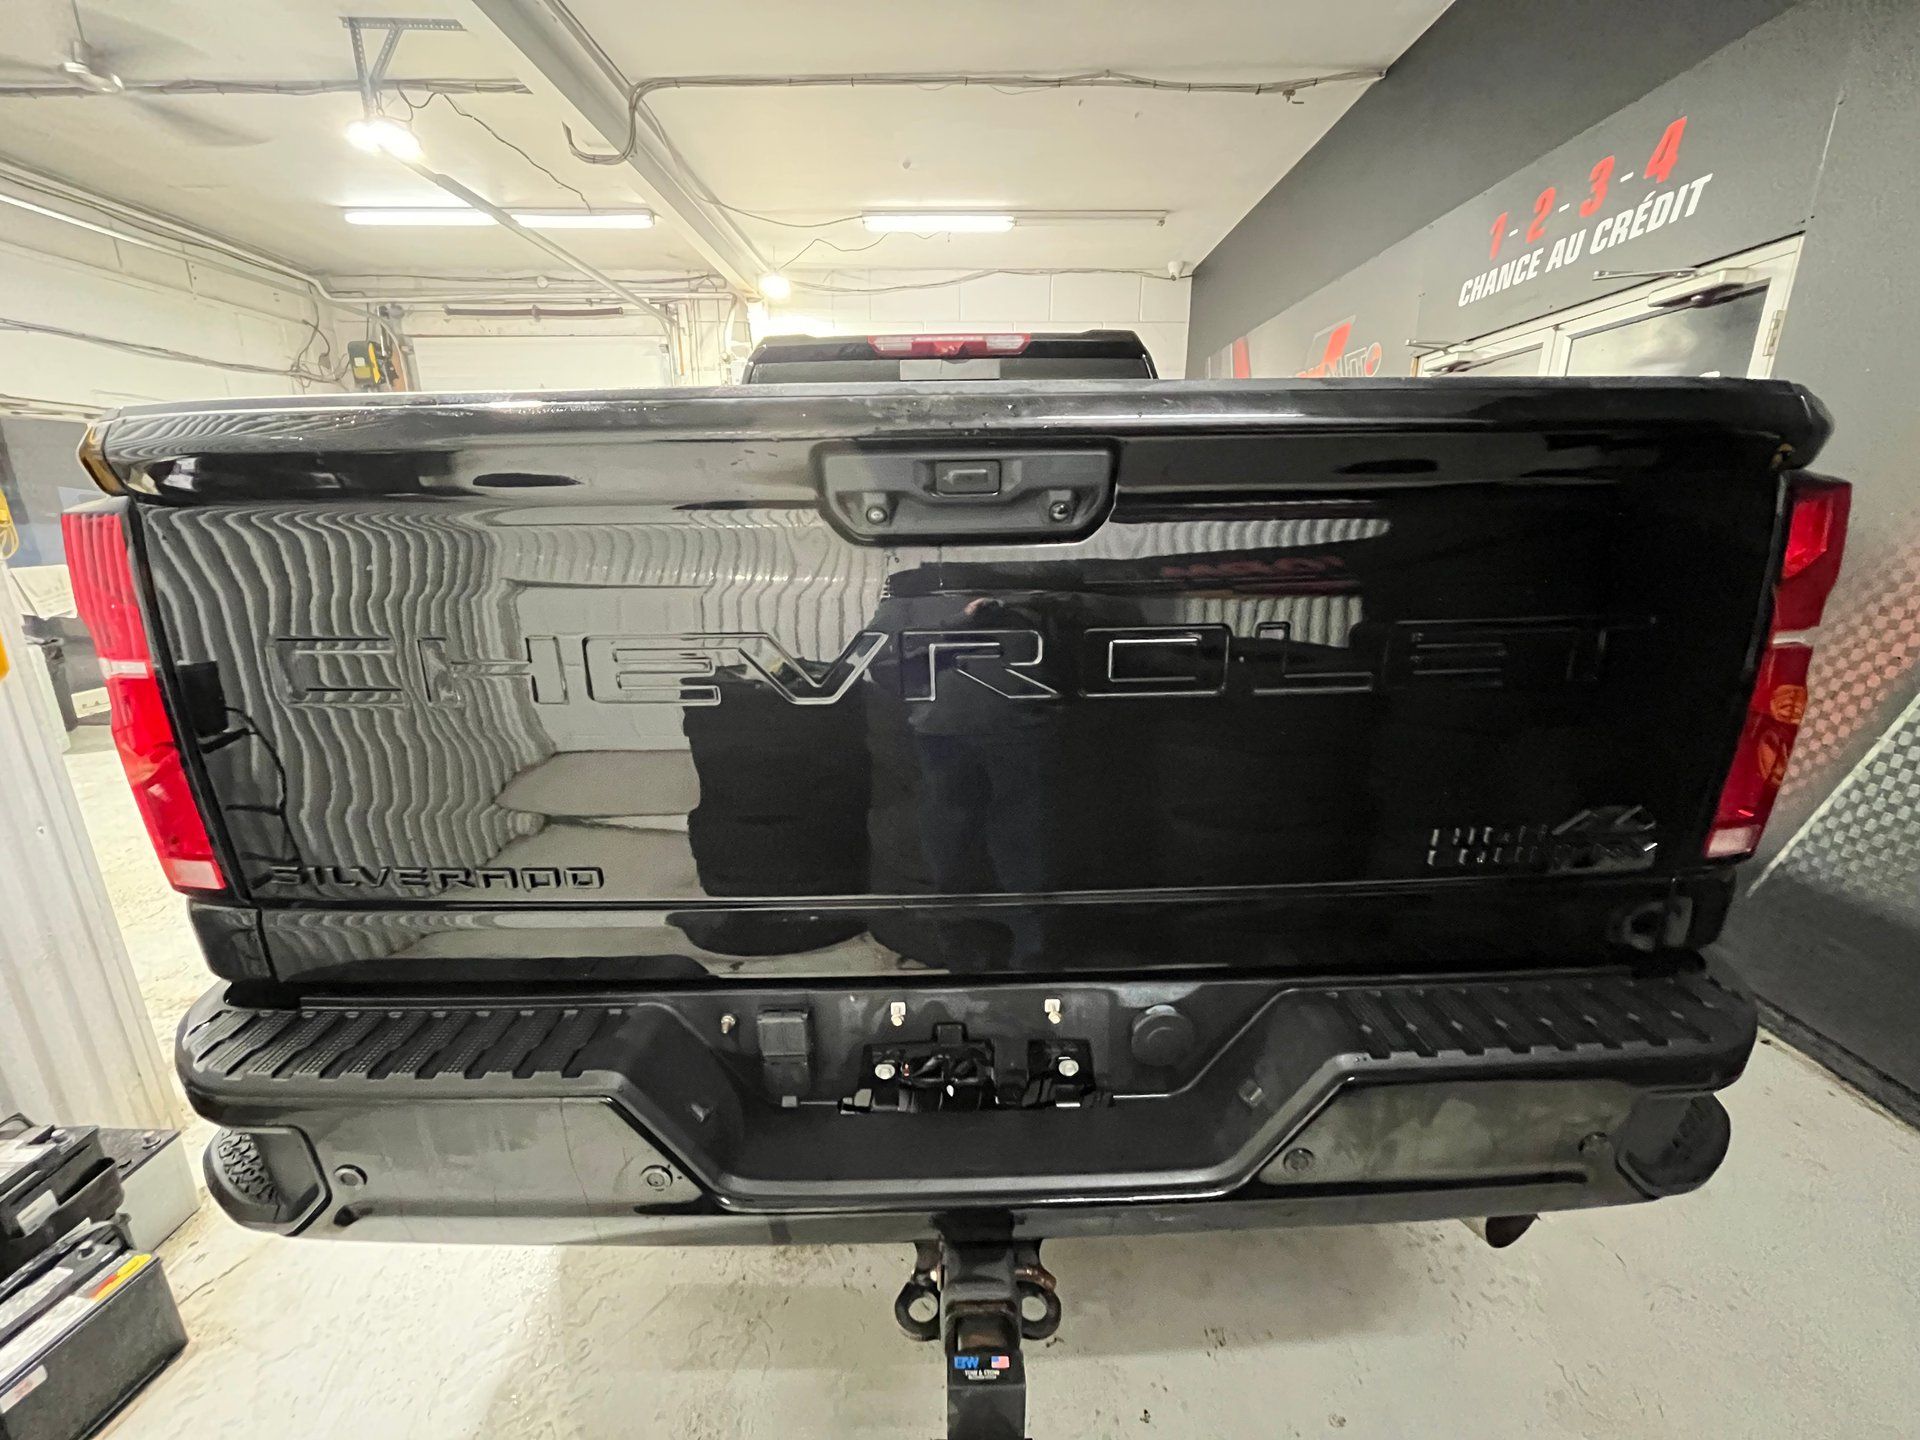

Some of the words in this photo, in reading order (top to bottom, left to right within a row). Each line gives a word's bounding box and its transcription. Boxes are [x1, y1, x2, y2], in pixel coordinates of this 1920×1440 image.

[1458, 248, 1544, 307] CHANCE
[1545, 229, 1587, 273] AU
[1589, 173, 1714, 255] CRÉDIT
[264, 866, 604, 891] SILVERADO
